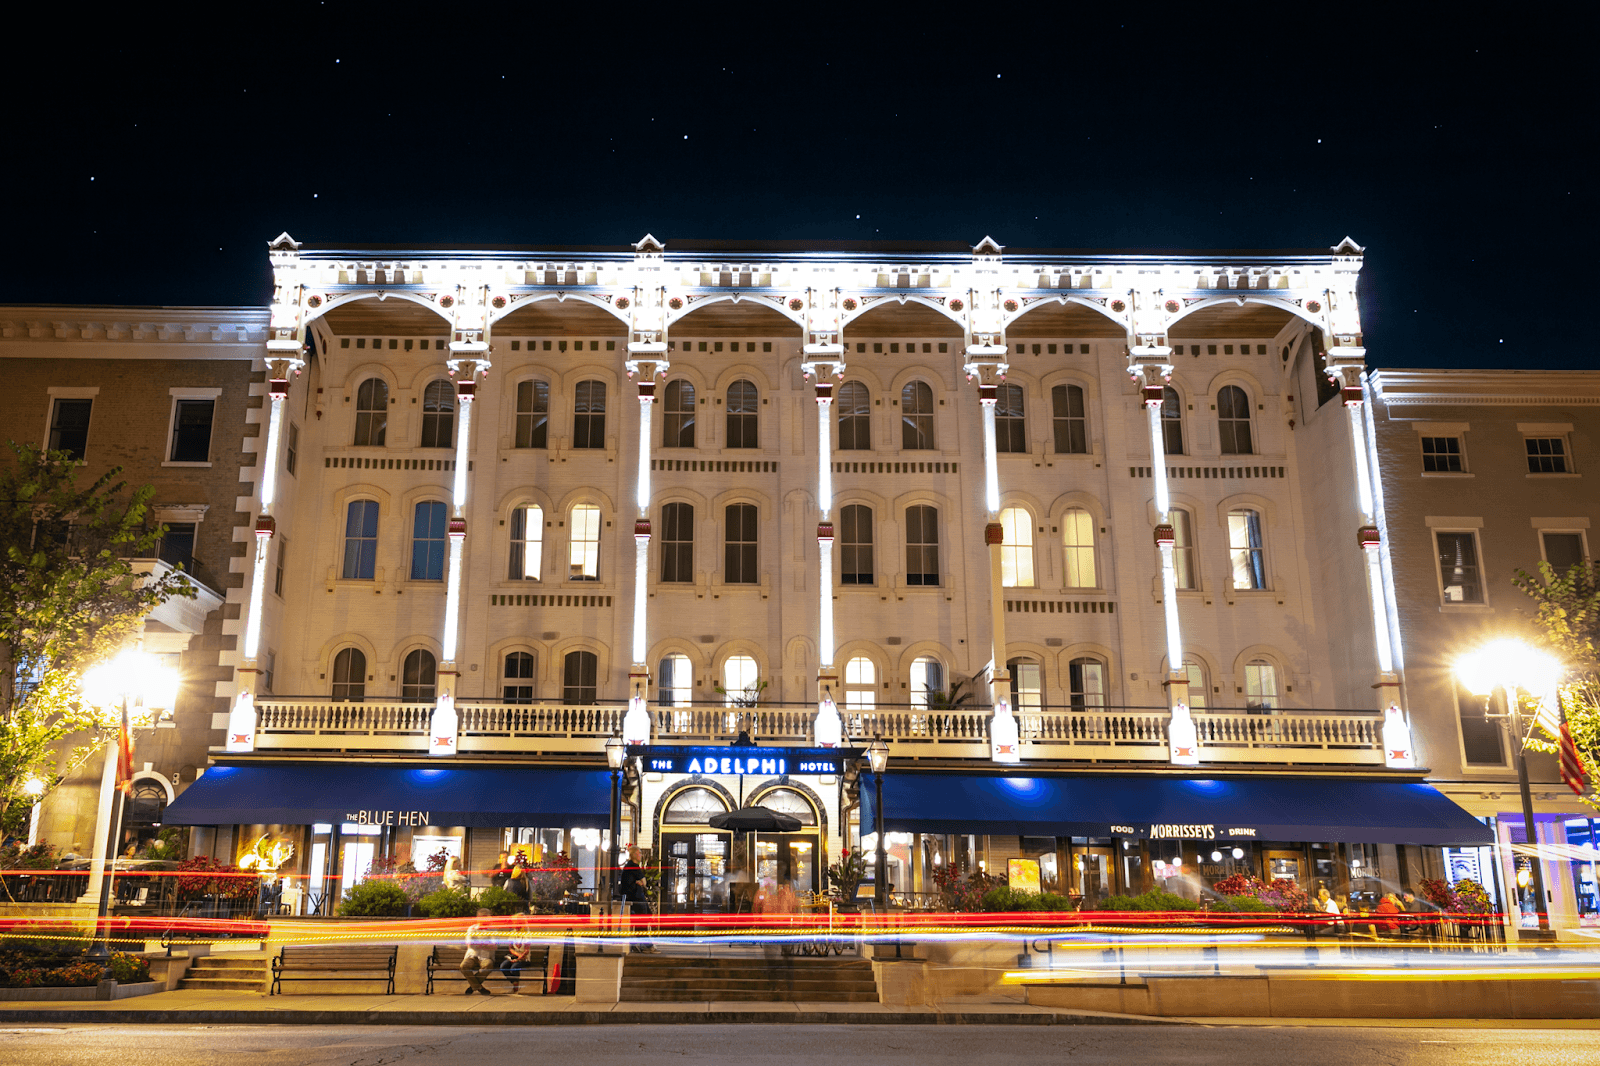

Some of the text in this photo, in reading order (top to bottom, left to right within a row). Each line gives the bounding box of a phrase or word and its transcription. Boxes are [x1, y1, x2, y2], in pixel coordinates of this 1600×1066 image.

[652, 757, 836, 774] THE ADELPHI HOTEL
[346, 810, 429, 826] THE BLUE HEN
[1110, 825, 1135, 834] FOOD
[1228, 828, 1257, 836] DRINK
